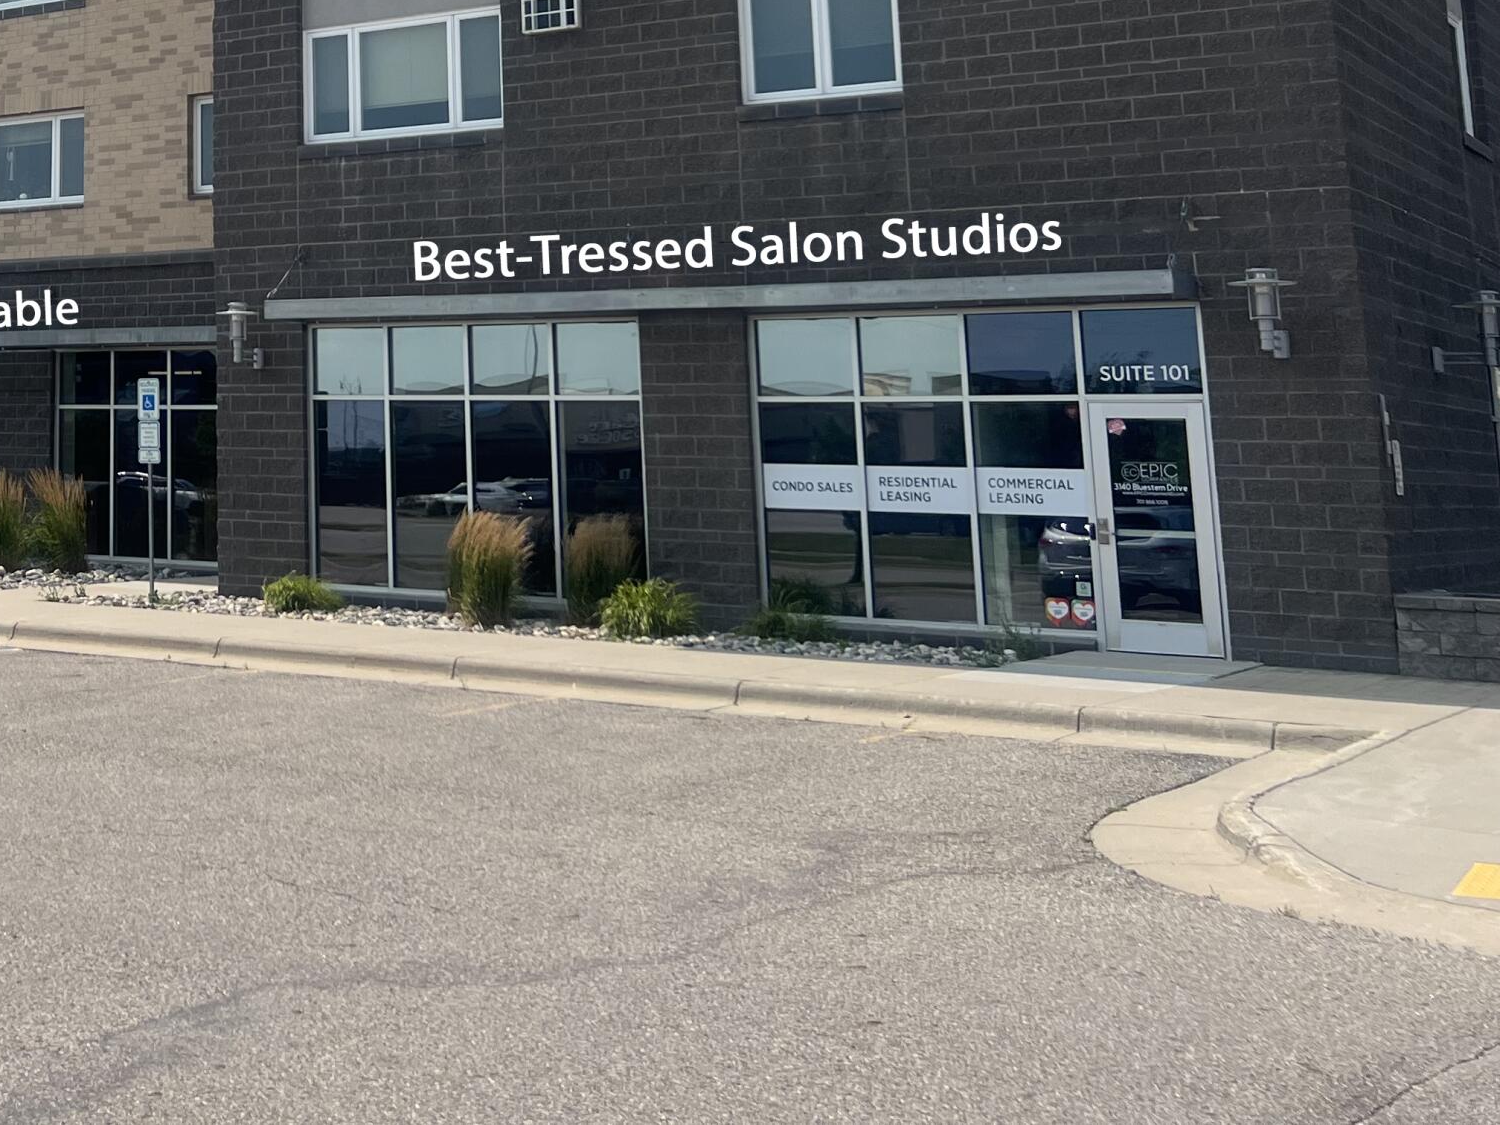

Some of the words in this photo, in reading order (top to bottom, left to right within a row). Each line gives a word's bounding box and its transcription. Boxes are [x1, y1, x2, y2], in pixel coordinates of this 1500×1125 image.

[1100, 365, 1156, 382] SUITE
[1160, 364, 1190, 381] 101
[1139, 463, 1179, 478] EPIC
[772, 481, 815, 492] CONDO
[817, 482, 854, 493] SALES
[879, 476, 958, 489] RESIDENTIAL
[988, 477, 1074, 490] COMMERCIAL
[1113, 482, 1132, 491] 3140
[1132, 483, 1166, 492] Bluestem
[1166, 483, 1188, 492] Drive
[880, 490, 932, 503] LEASING
[989, 492, 1044, 505] LEASING
